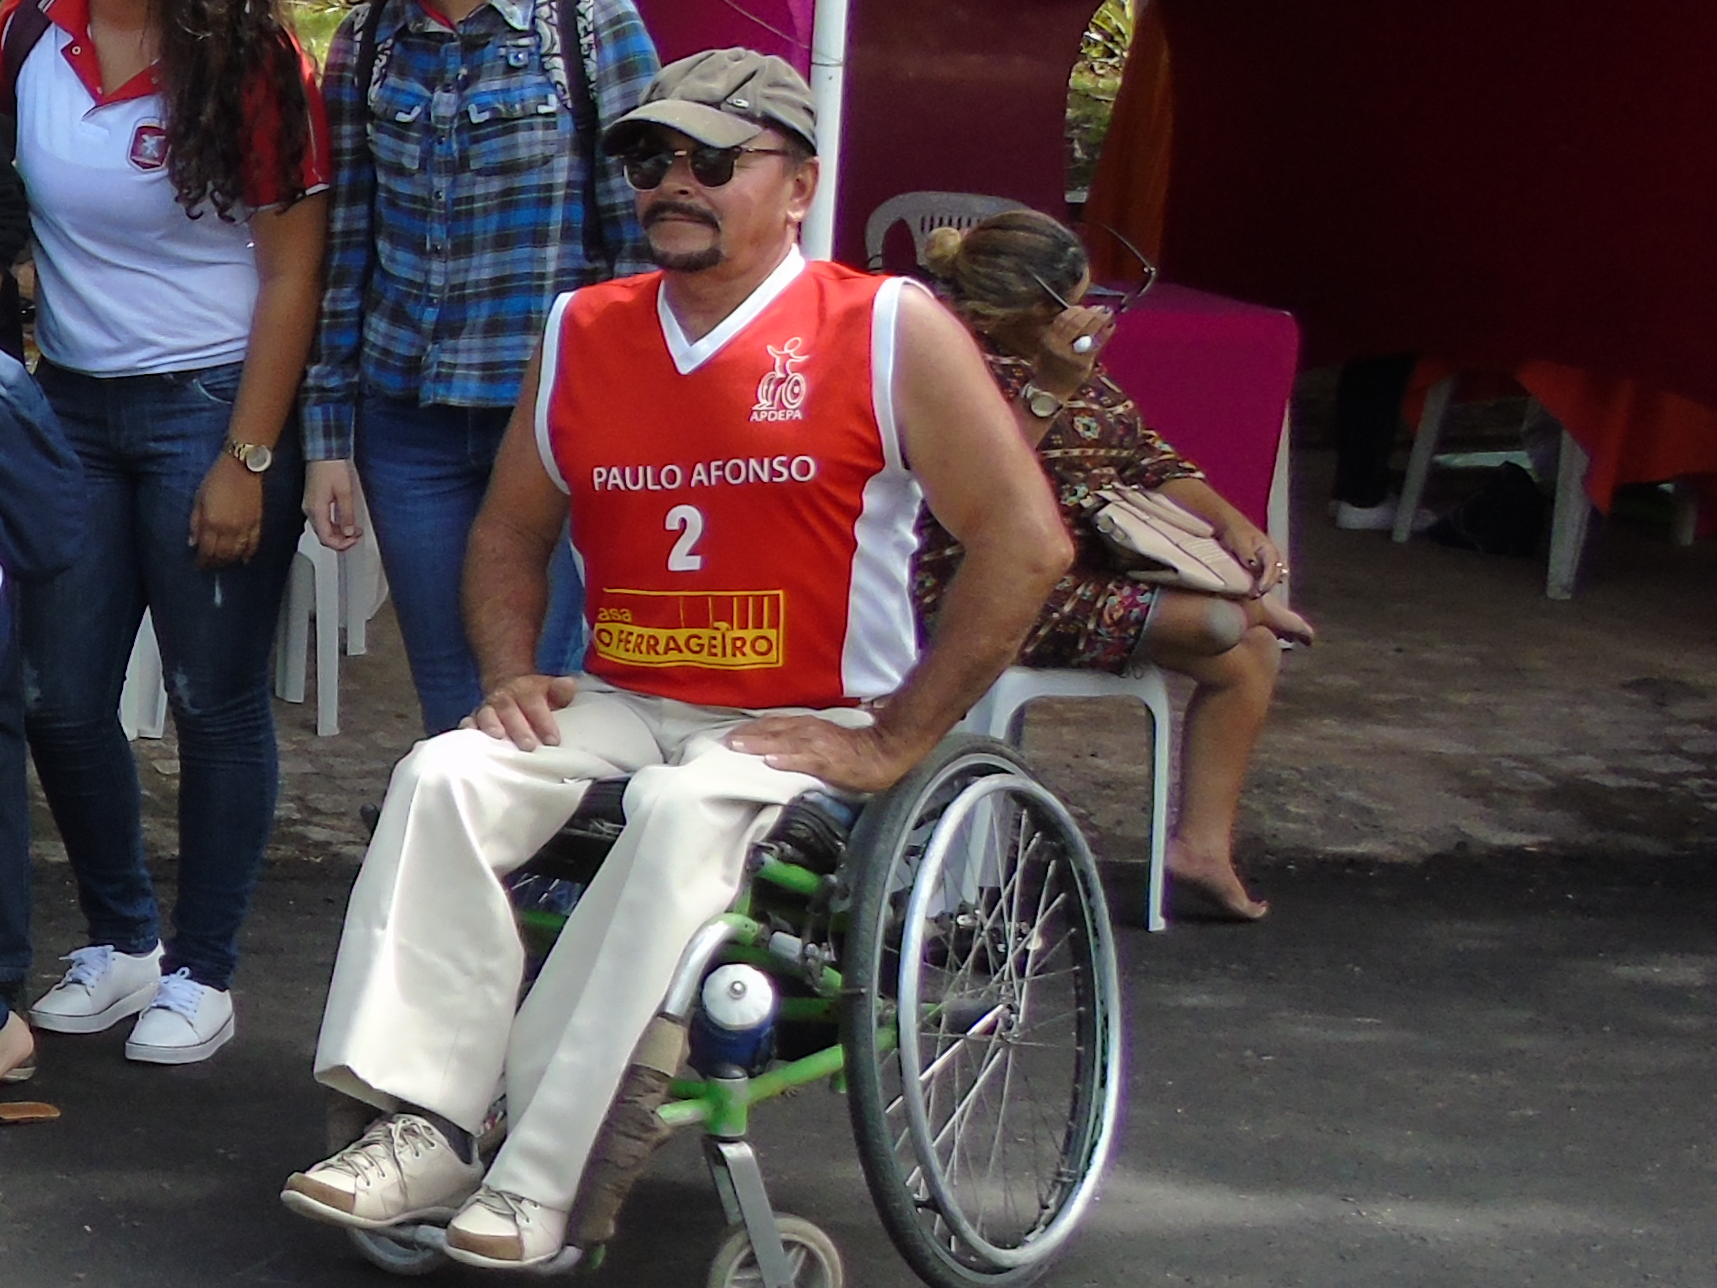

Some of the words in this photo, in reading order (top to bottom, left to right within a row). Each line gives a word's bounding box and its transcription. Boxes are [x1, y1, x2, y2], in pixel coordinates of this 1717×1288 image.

[749, 409, 803, 423] APDEPA
[592, 464, 682, 492] PAULO
[690, 454, 817, 488] AFONSO
[664, 504, 704, 572] 2
[597, 607, 633, 623] asa
[595, 628, 614, 648] O
[616, 626, 774, 658] FERRAGEIRO
